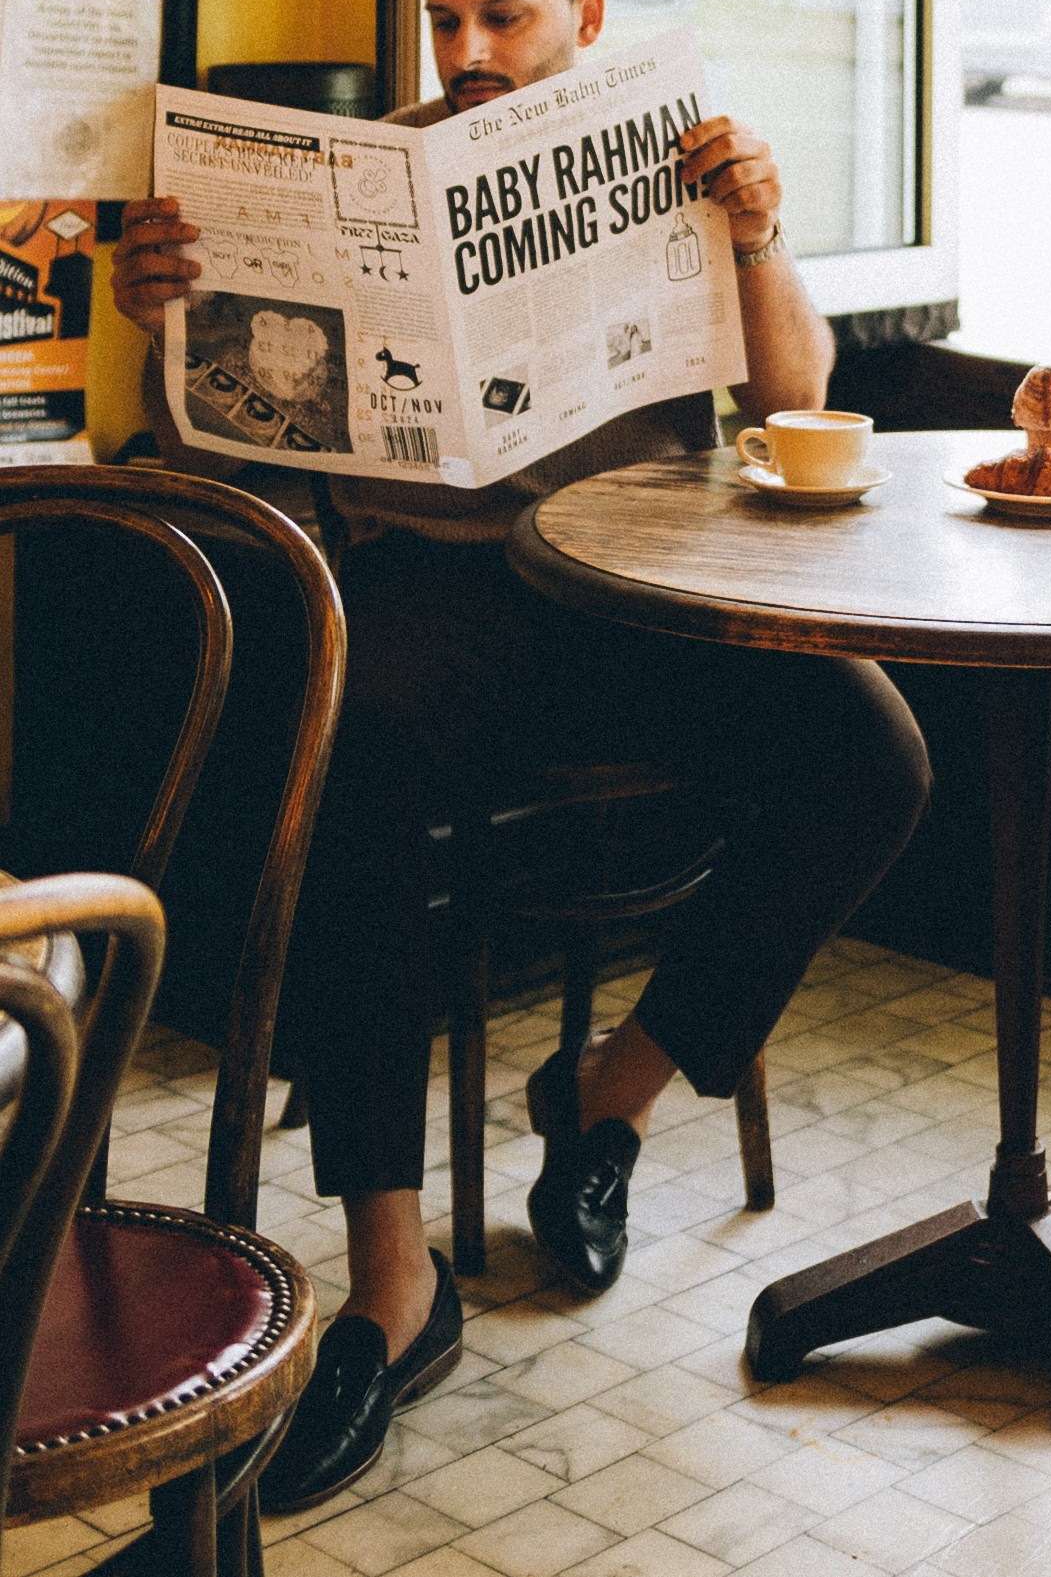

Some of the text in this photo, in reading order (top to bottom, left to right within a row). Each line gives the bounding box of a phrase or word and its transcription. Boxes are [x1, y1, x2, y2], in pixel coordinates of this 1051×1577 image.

[468, 116, 503, 141] The
[507, 101, 549, 127] New
[553, 82, 601, 110] Baby
[605, 58, 657, 89] Times
[173, 149, 228, 170] SECRET
[446, 154, 541, 241] BABY
[551, 92, 702, 201] RAHMAN
[340, 225, 421, 245] FREE GAZA
[454, 196, 600, 296] COMING
[242, 256, 263, 269] OR
[685, 355, 706, 368] 2024
[613, 371, 646, 392] OCT/NOV
[369, 391, 443, 415] OCT/NOV
[558, 401, 588, 421] COMING
[497, 434, 529, 456] RAHMAN
[502, 428, 521, 444] BABY
